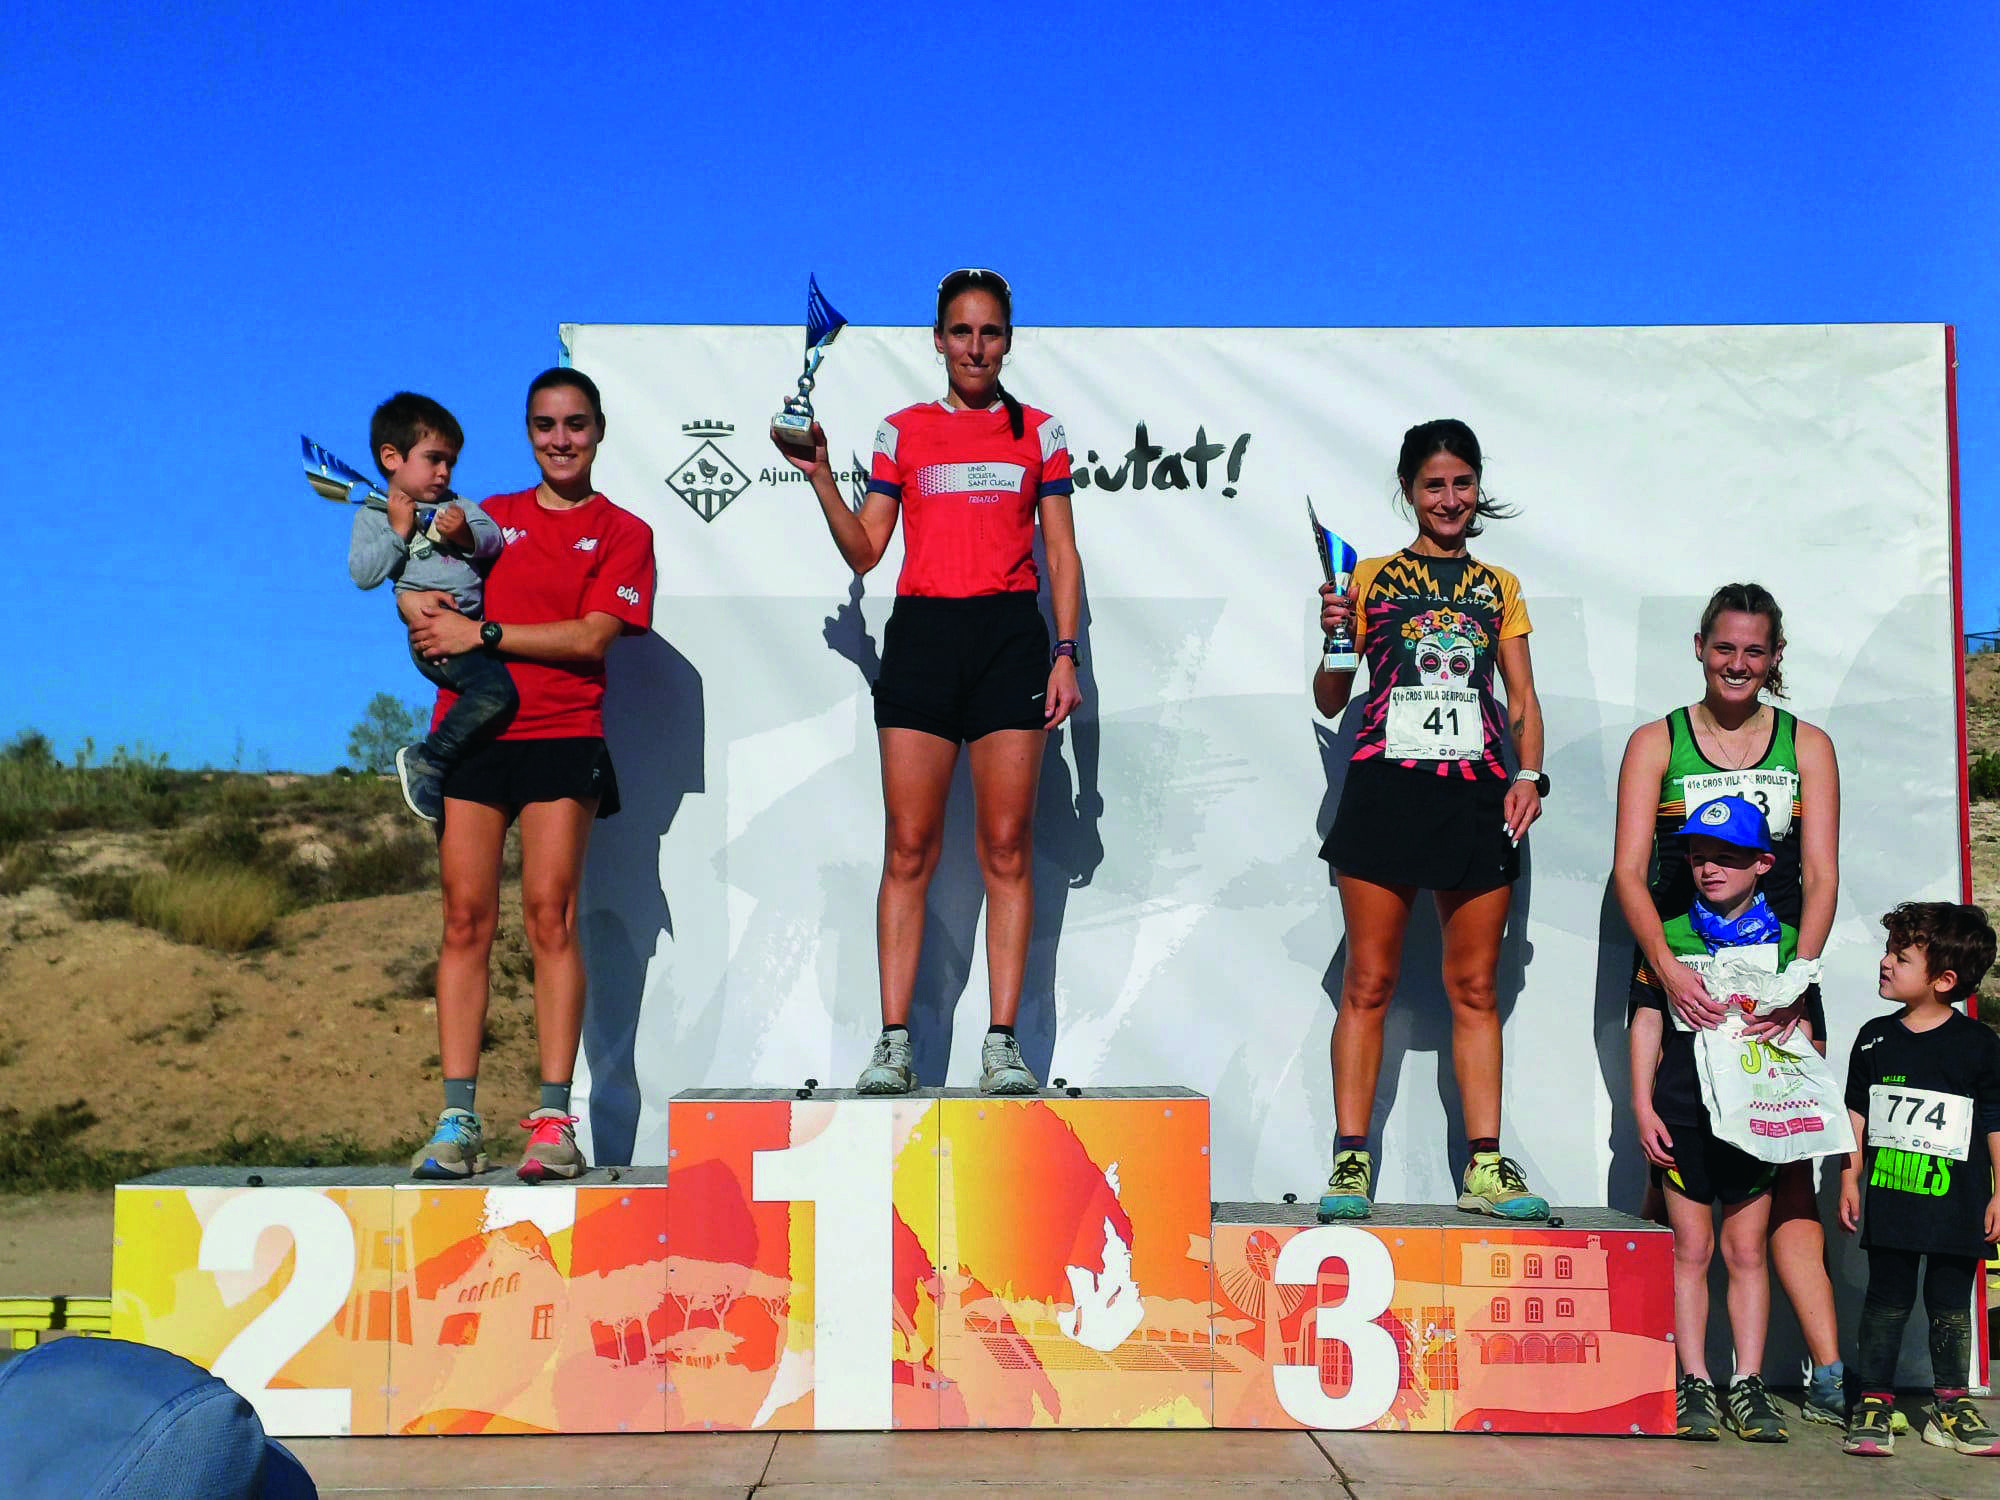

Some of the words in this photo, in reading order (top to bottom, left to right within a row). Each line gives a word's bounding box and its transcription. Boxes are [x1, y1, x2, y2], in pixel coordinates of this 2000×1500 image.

[967, 480, 988, 488] SANT
[989, 479, 1016, 488] CUGAT
[616, 585, 640, 606] edp
[1423, 690, 1440, 701] VILA
[1422, 706, 1459, 736] 41
[1702, 778, 1723, 788] CROS
[1755, 774, 1788, 786] RIPOLLET
[1887, 1093, 1947, 1131] 774
[752, 1099, 893, 1431] 1
[198, 1186, 356, 1436] 2
[1272, 1225, 1401, 1430] 3
